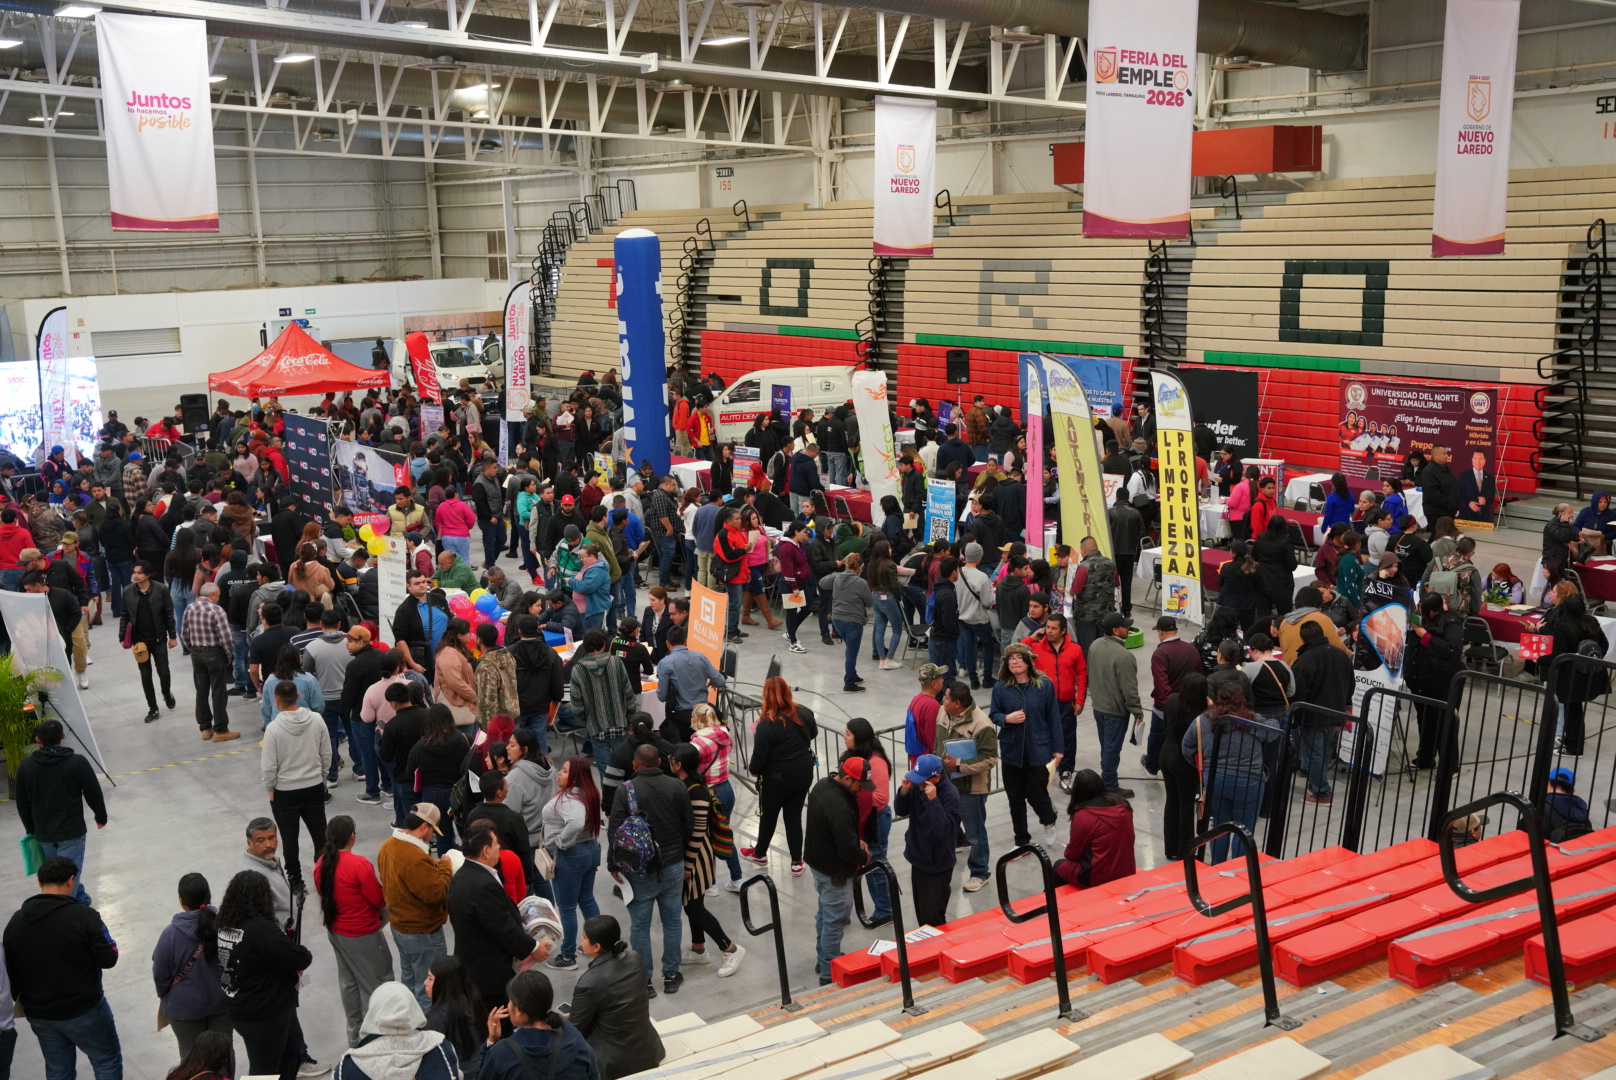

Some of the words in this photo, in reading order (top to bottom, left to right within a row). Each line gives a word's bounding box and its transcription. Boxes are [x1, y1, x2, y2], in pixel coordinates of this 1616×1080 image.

[1120, 49, 1159, 66] FERIA
[1162, 53, 1187, 68] DEL
[126, 90, 192, 109] Juntos
[1146, 89, 1184, 107] 2026
[1595, 96, 1616, 114] SE
[137, 107, 167, 115] hacemos
[138, 112, 191, 133] posible
[1458, 130, 1494, 143] NUEVO
[1457, 144, 1493, 155] LAREDO
[720, 181, 731, 190] 150
[891, 178, 920, 186] NUEVO
[891, 186, 920, 194] LAREDO
[507, 304, 516, 340] Juntos
[281, 353, 332, 369] Coca-Cola
[1371, 388, 1418, 399] UNIVERSIDAD
[1434, 394, 1459, 402] NORTE
[1388, 398, 1398, 406] DE
[1400, 399, 1442, 409] TAMAULIPAS
[1395, 413, 1413, 424] ¡Elige
[1415, 416, 1457, 426] Transformar
[1206, 420, 1237, 435] der
[1416, 425, 1440, 434] Futuro!
[1225, 436, 1246, 446] better.
[1067, 416, 1091, 537] AUTOMOTRI
[1164, 431, 1179, 574] LIMPIEZA
[1177, 432, 1196, 577] PROFUNDA
[1376, 582, 1393, 596] SLN
[693, 619, 708, 638] REAL
[708, 628, 718, 642] INN
